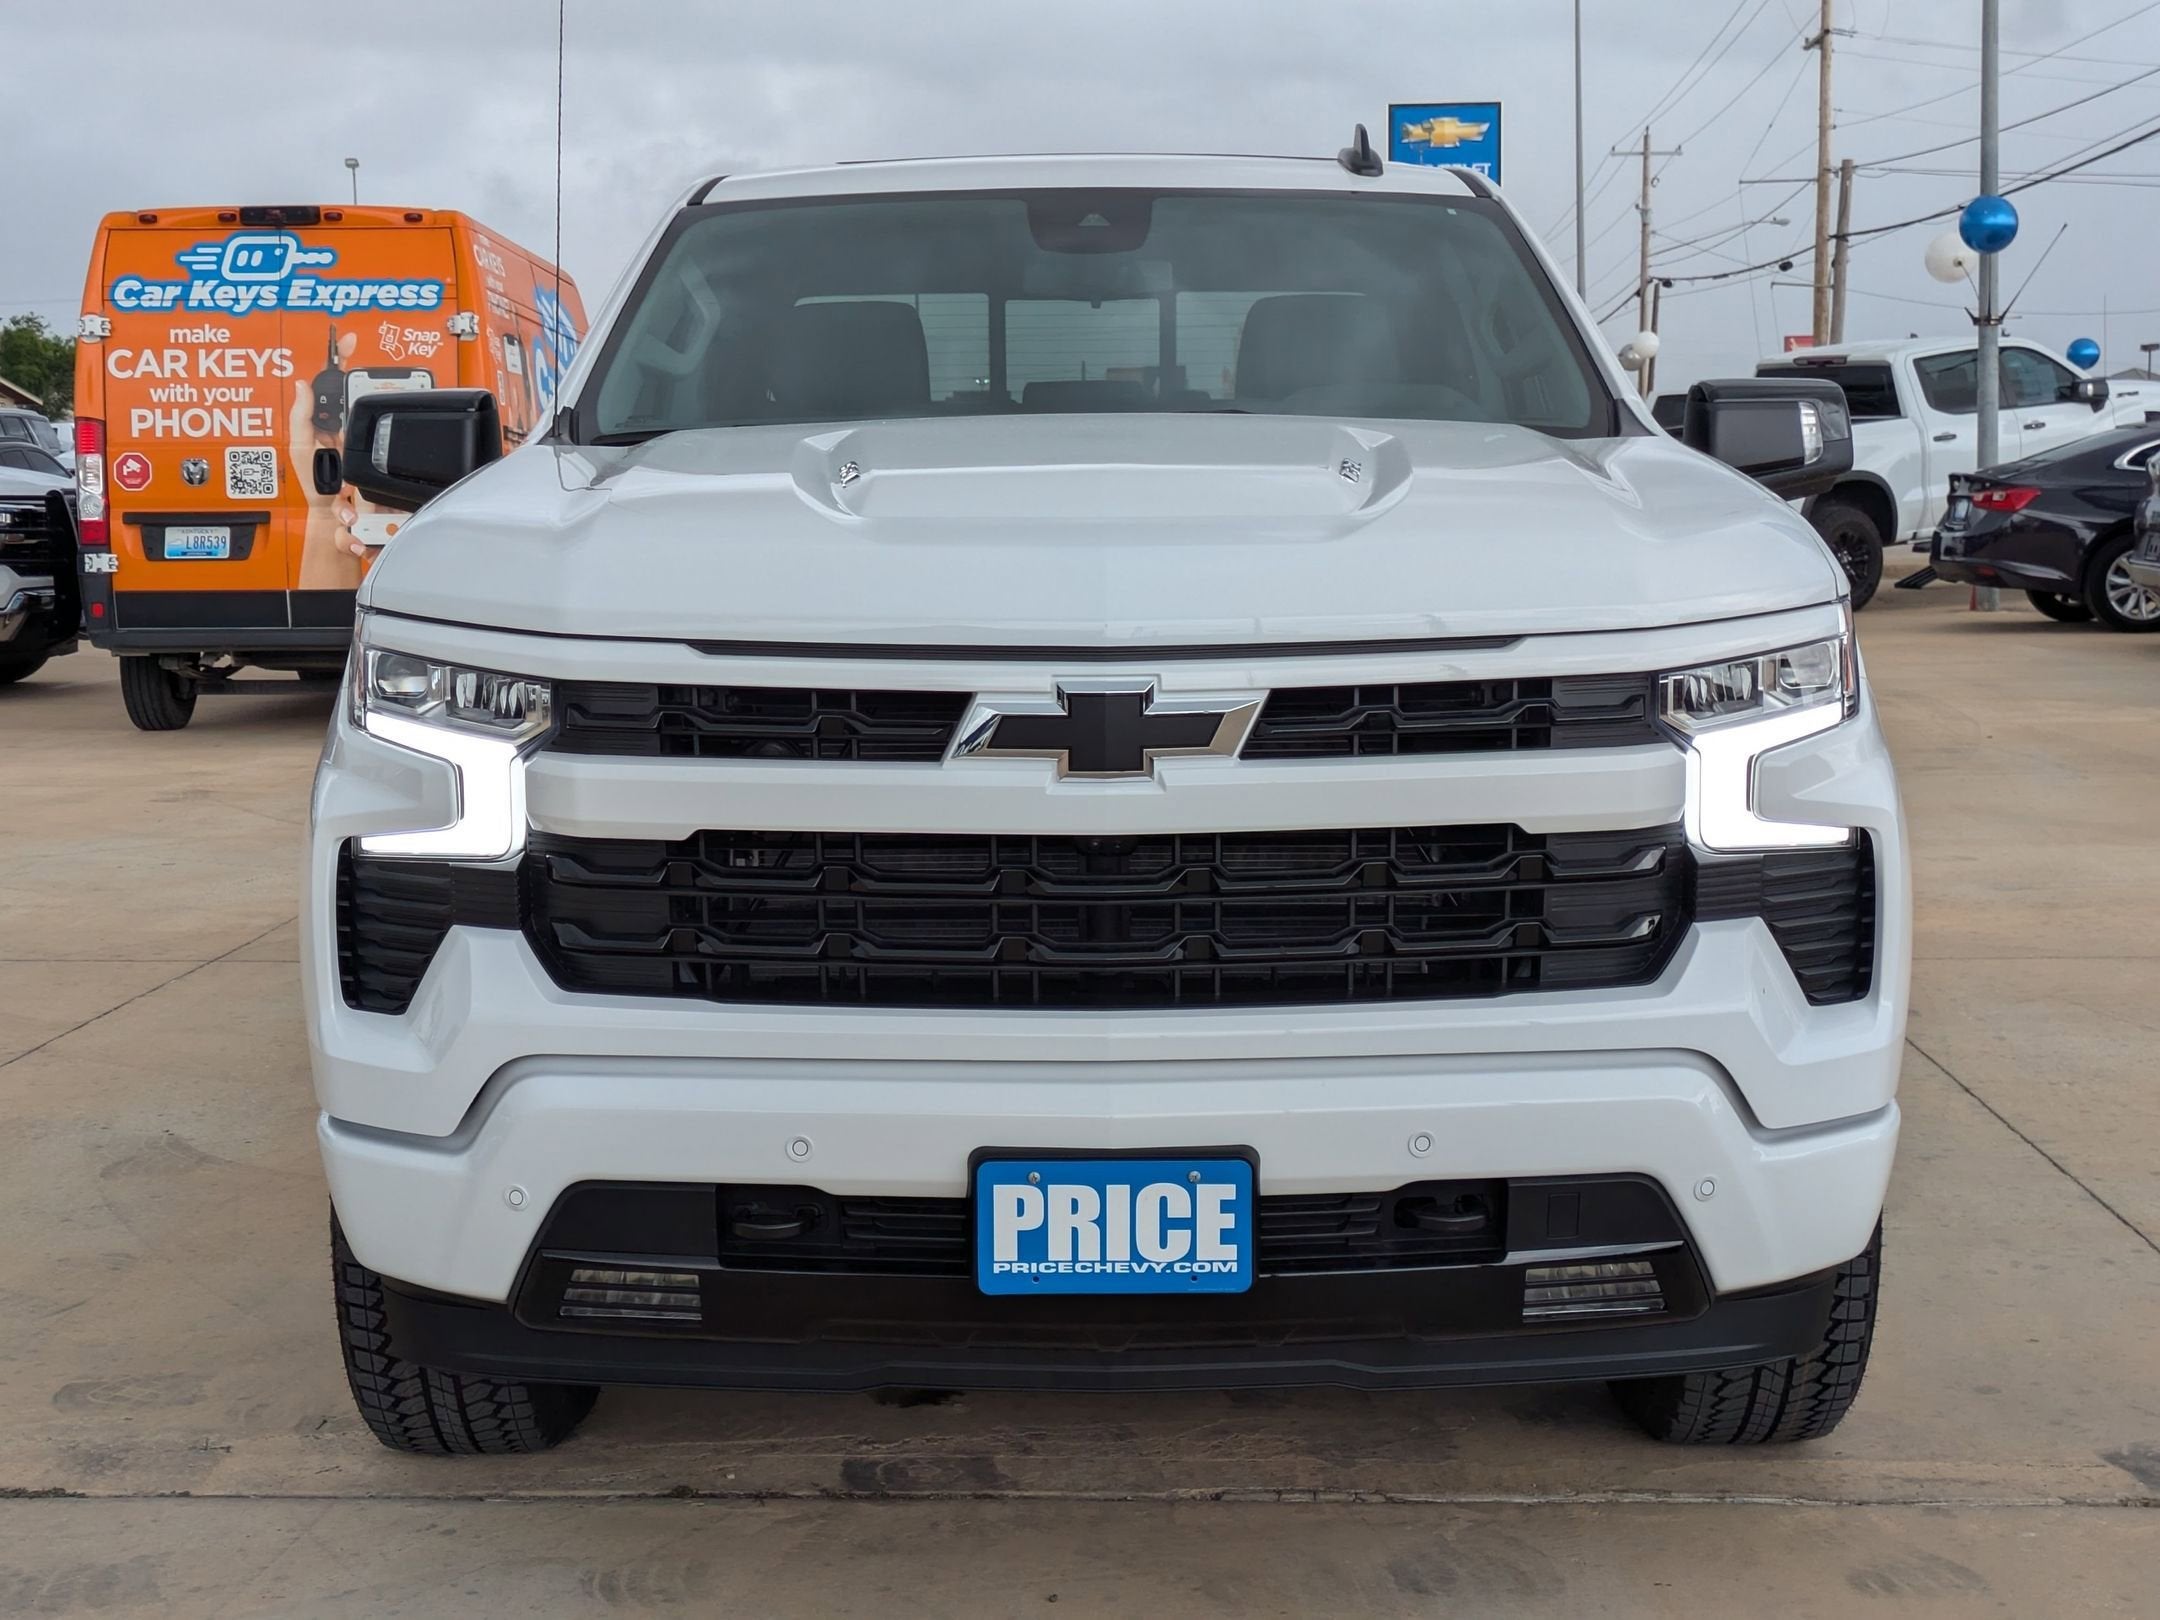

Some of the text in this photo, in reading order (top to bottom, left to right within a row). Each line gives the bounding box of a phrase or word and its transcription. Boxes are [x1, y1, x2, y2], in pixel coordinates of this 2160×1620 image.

[113, 279, 438, 313] Car Keys Express
[169, 324, 231, 344] make
[402, 328, 441, 344] Snap
[107, 348, 294, 379] CAR KEYS
[149, 383, 253, 406] with your
[130, 407, 273, 438] PHONE!
[186, 535, 227, 550] L8R539
[993, 1182, 1238, 1262] PRICE
[993, 1262, 1238, 1274] PRICECHEVY.COM
